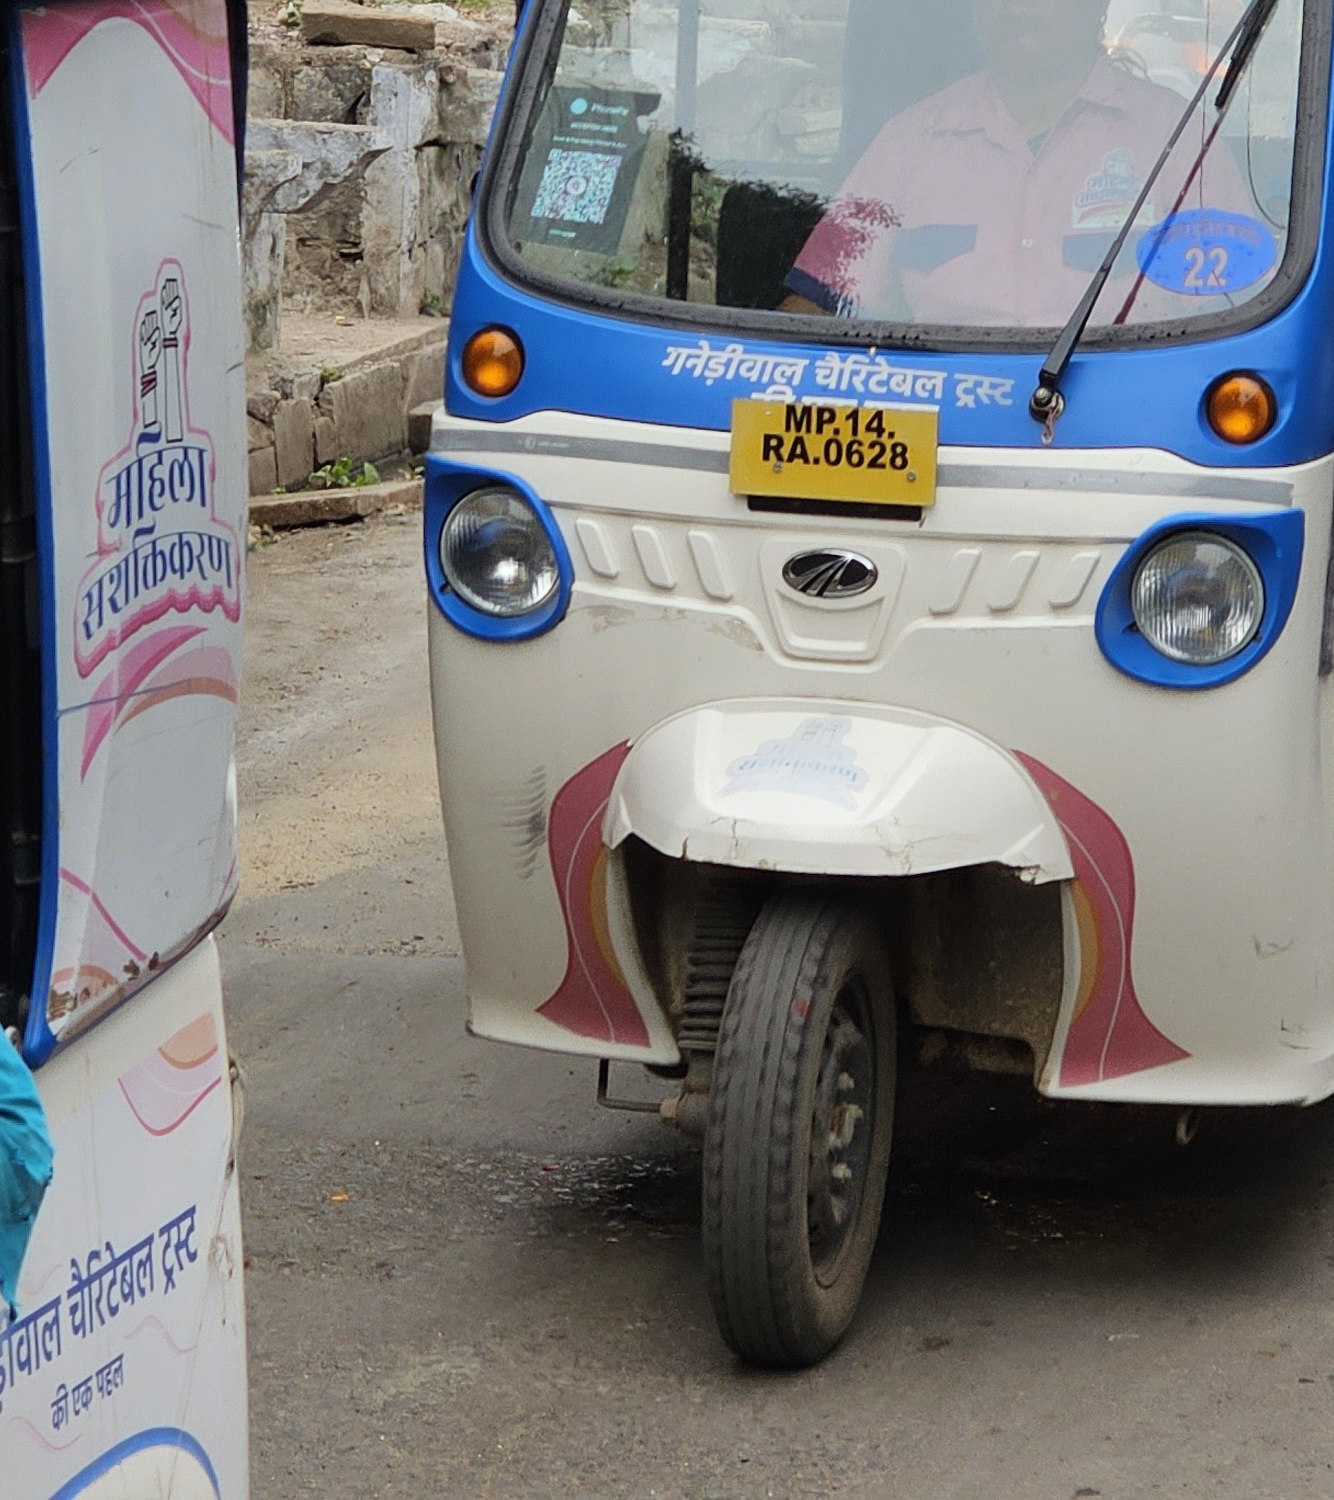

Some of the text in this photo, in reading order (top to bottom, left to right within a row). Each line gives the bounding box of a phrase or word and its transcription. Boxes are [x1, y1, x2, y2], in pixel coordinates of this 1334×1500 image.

[1184, 247, 1228, 287] 22
[662, 341, 810, 387] गनेड़ीवाल
[814, 351, 948, 399] चैरिटेबल
[953, 373, 1015, 409] ट्रस्ट
[762, 434, 909, 470] RA.0628
[784, 405, 896, 439] MP.14.
[105, 421, 207, 530] महिला
[80, 516, 233, 641] सशक्तिकरण
[66, 1233, 155, 1339] चैरिटेबल
[158, 1204, 199, 1295] ट्रस्ट
[51, 1352, 125, 1431] की एक पहल
